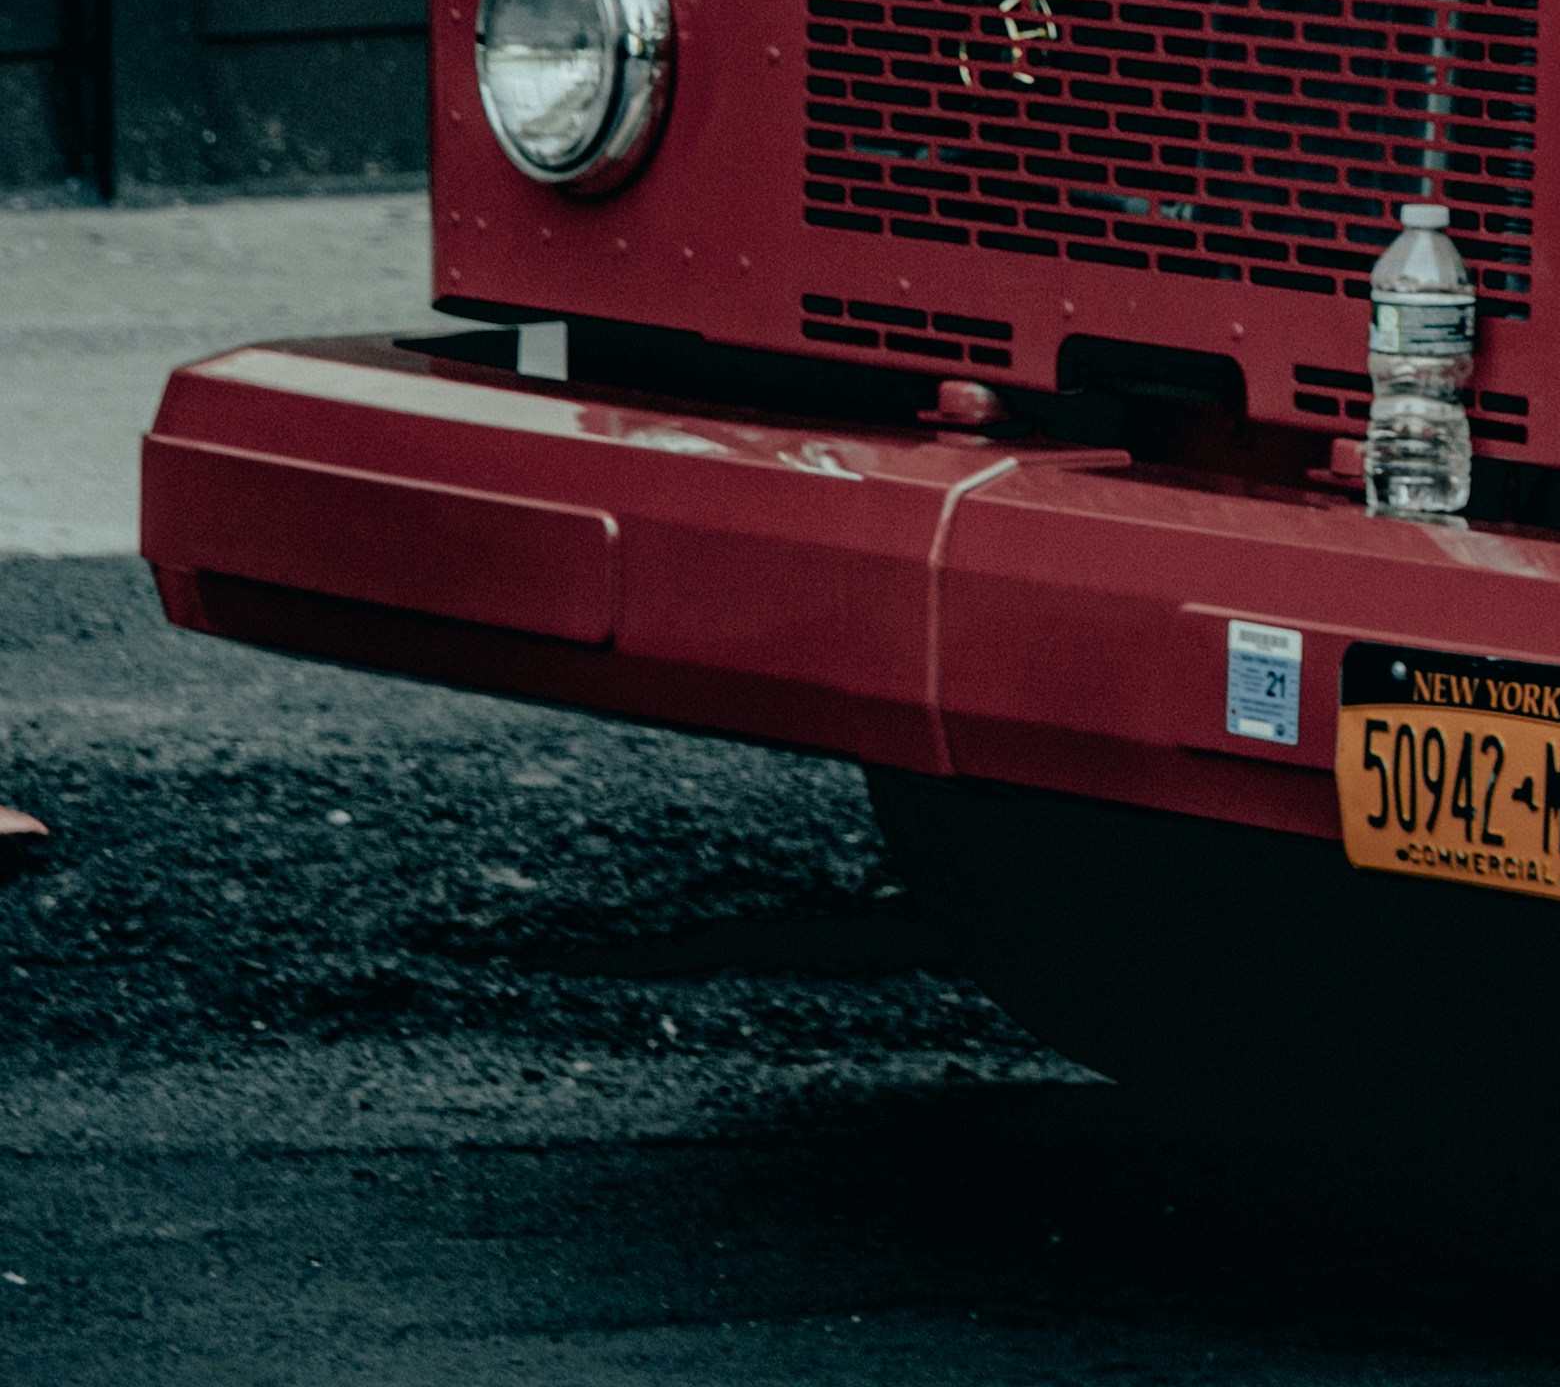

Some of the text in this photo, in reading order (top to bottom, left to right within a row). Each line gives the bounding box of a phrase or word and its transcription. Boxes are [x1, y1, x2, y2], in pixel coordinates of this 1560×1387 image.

[1266, 670, 1286, 699] 21
[1412, 670, 1480, 706] NEW
[1363, 718, 1506, 847] 50942
[1406, 842, 1555, 886] COMMERCIAL
